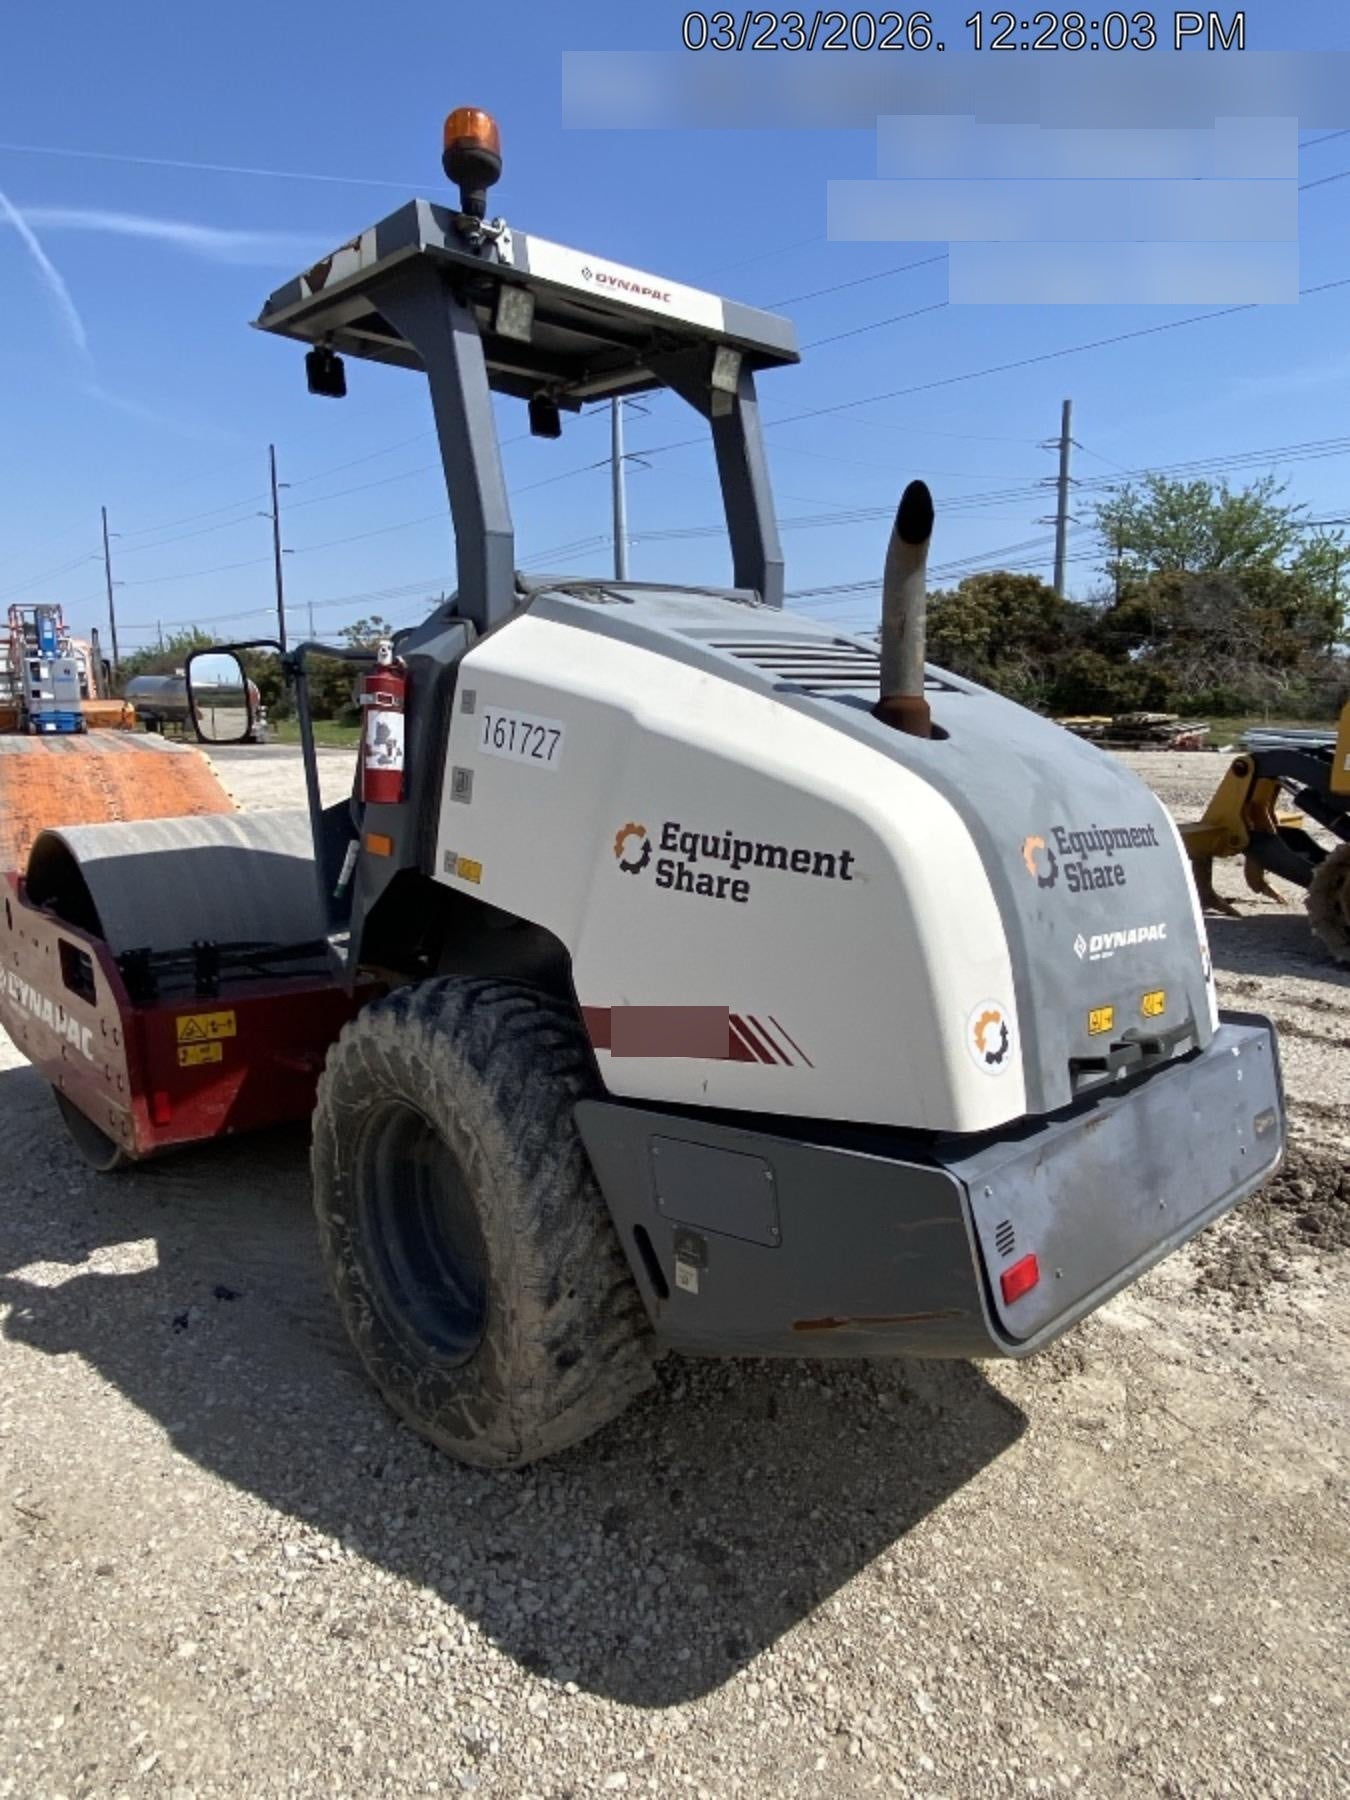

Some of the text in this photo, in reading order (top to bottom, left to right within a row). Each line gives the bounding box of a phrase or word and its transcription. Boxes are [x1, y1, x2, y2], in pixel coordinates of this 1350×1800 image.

[596, 273, 671, 302] DYNAPAC
[483, 715, 561, 761] 161727
[659, 821, 855, 881] Equipment
[1051, 823, 1159, 860] Equipment
[656, 859, 750, 903] Share
[1064, 861, 1126, 893] Share
[1089, 923, 1167, 953] DYNAPAC
